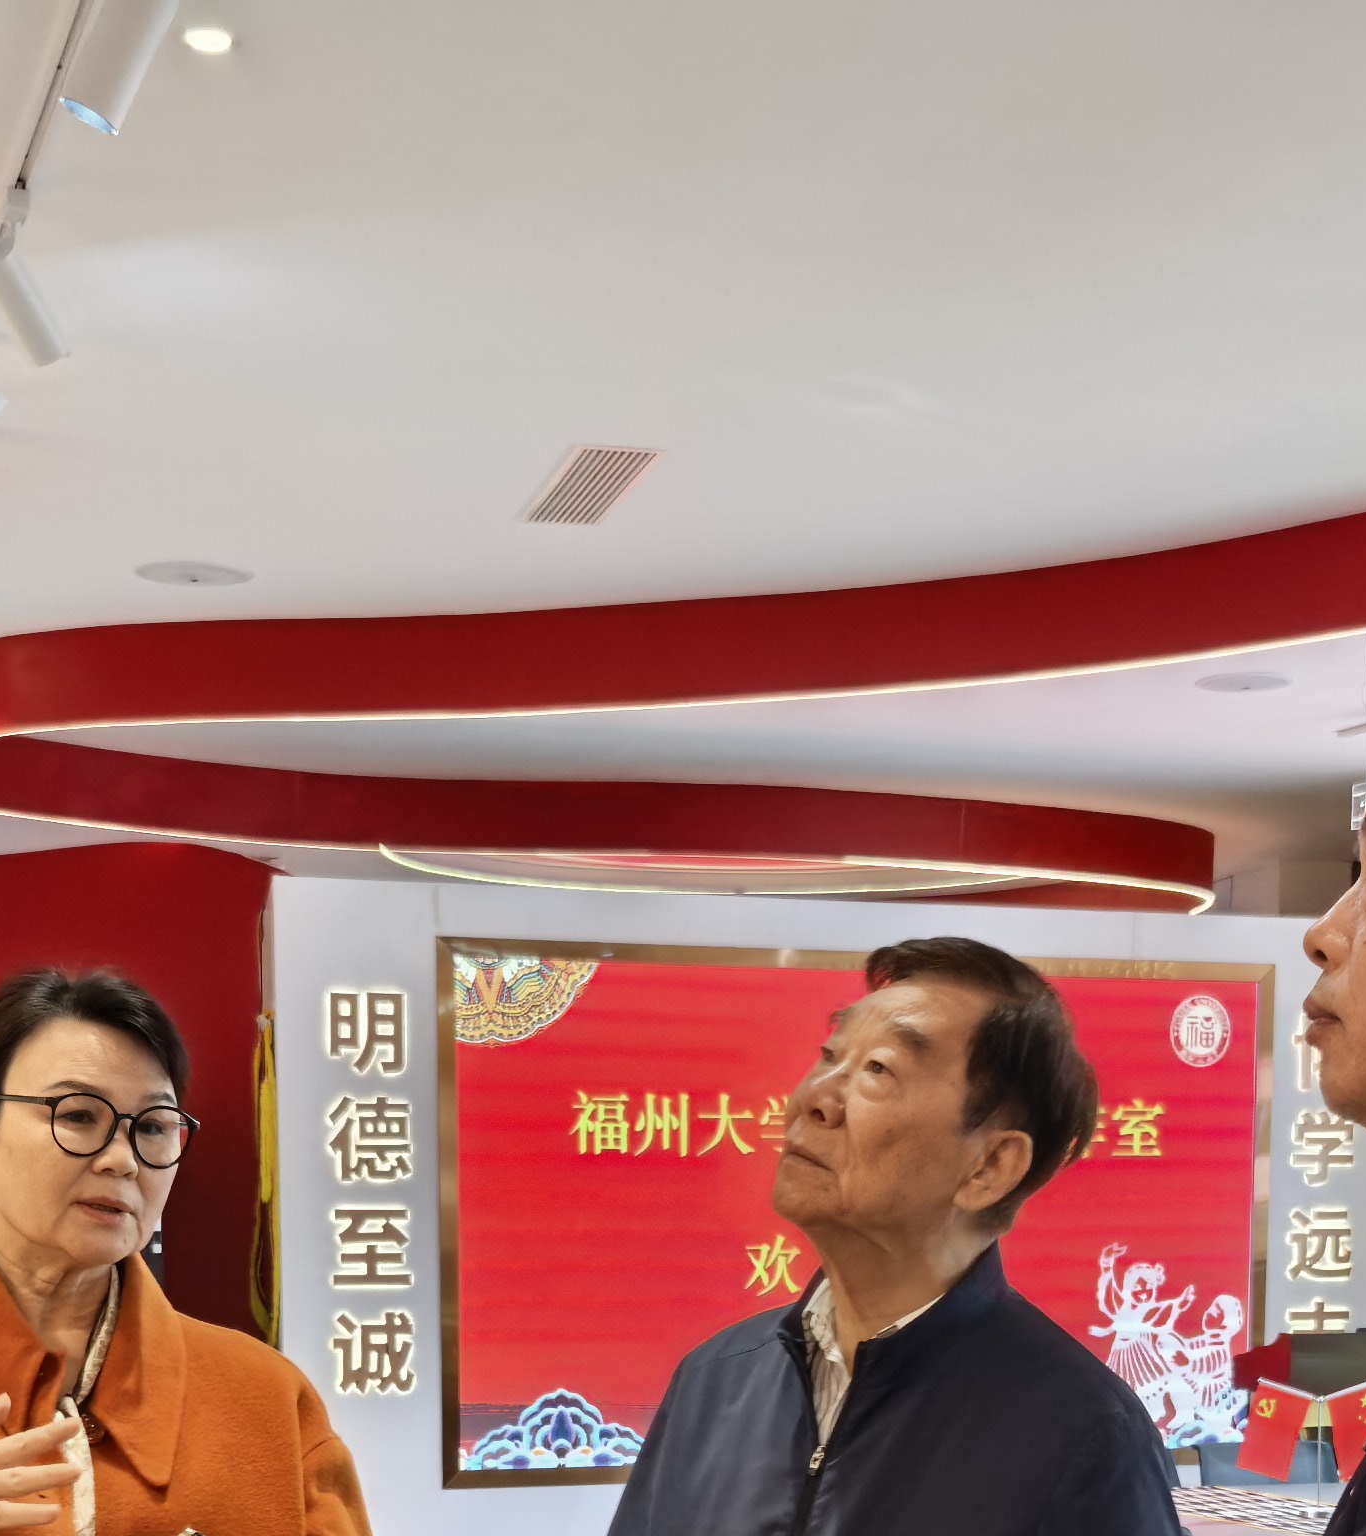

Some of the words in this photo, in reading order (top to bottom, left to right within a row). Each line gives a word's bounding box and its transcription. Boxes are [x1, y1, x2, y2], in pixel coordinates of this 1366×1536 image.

[328, 991, 416, 1394] 明德至诚
[744, 1234, 802, 1296] 欢
